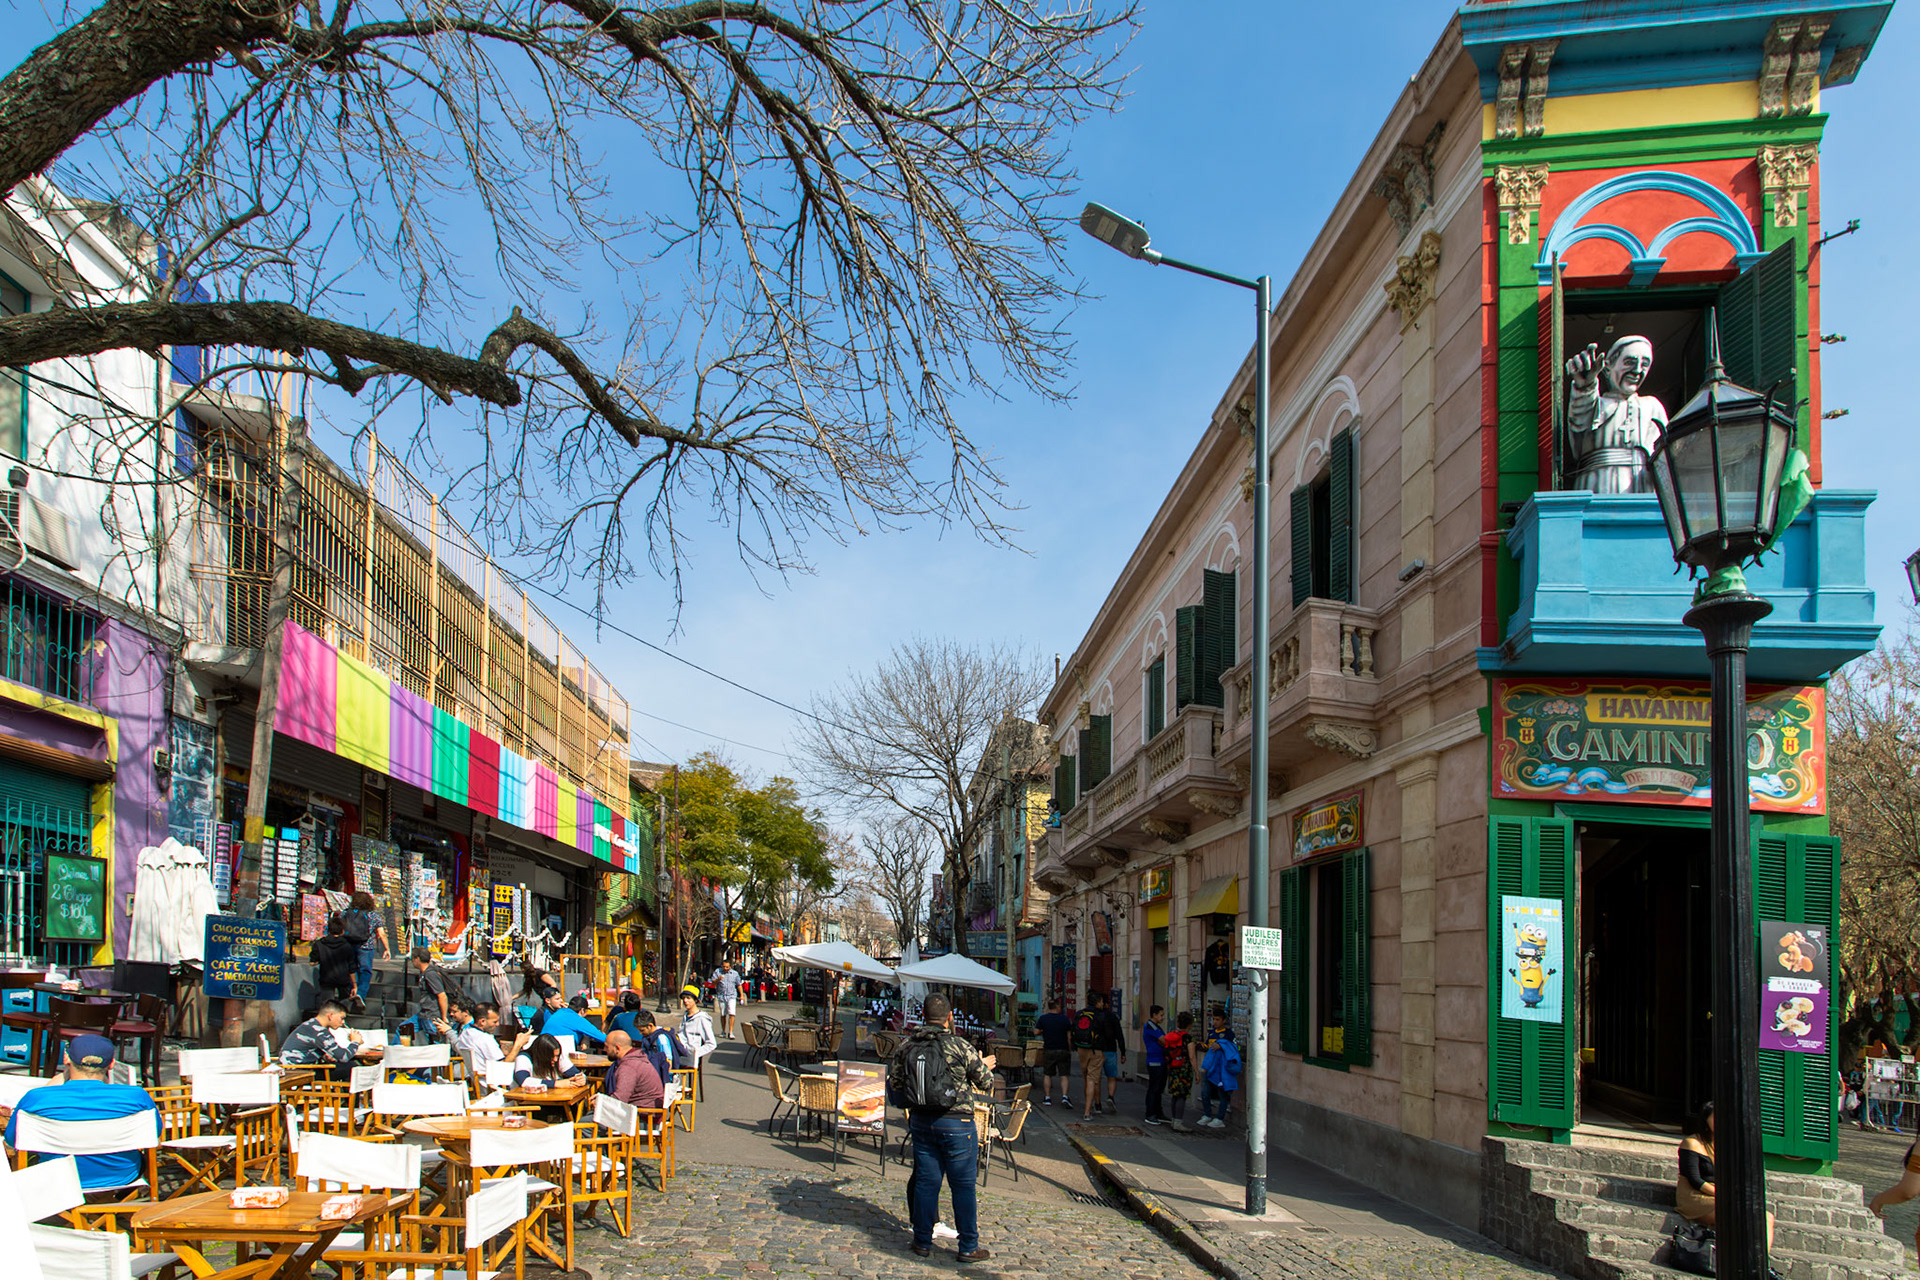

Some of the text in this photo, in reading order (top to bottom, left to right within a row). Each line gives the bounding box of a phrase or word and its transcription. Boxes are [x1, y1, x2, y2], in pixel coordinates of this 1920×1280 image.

[1546, 720, 1775, 770] CAMINIO
[1786, 740, 1794, 751] H
[1625, 769, 1693, 790] DESDE 1948
[51, 883, 61, 900] 2
[212, 923, 275, 939] CHOCOLATE
[1244, 929, 1280, 940] JUBILESE
[211, 935, 278, 948] CON CHURROS
[1246, 938, 1279, 947] MUJERES
[210, 960, 241, 971] CAFE
